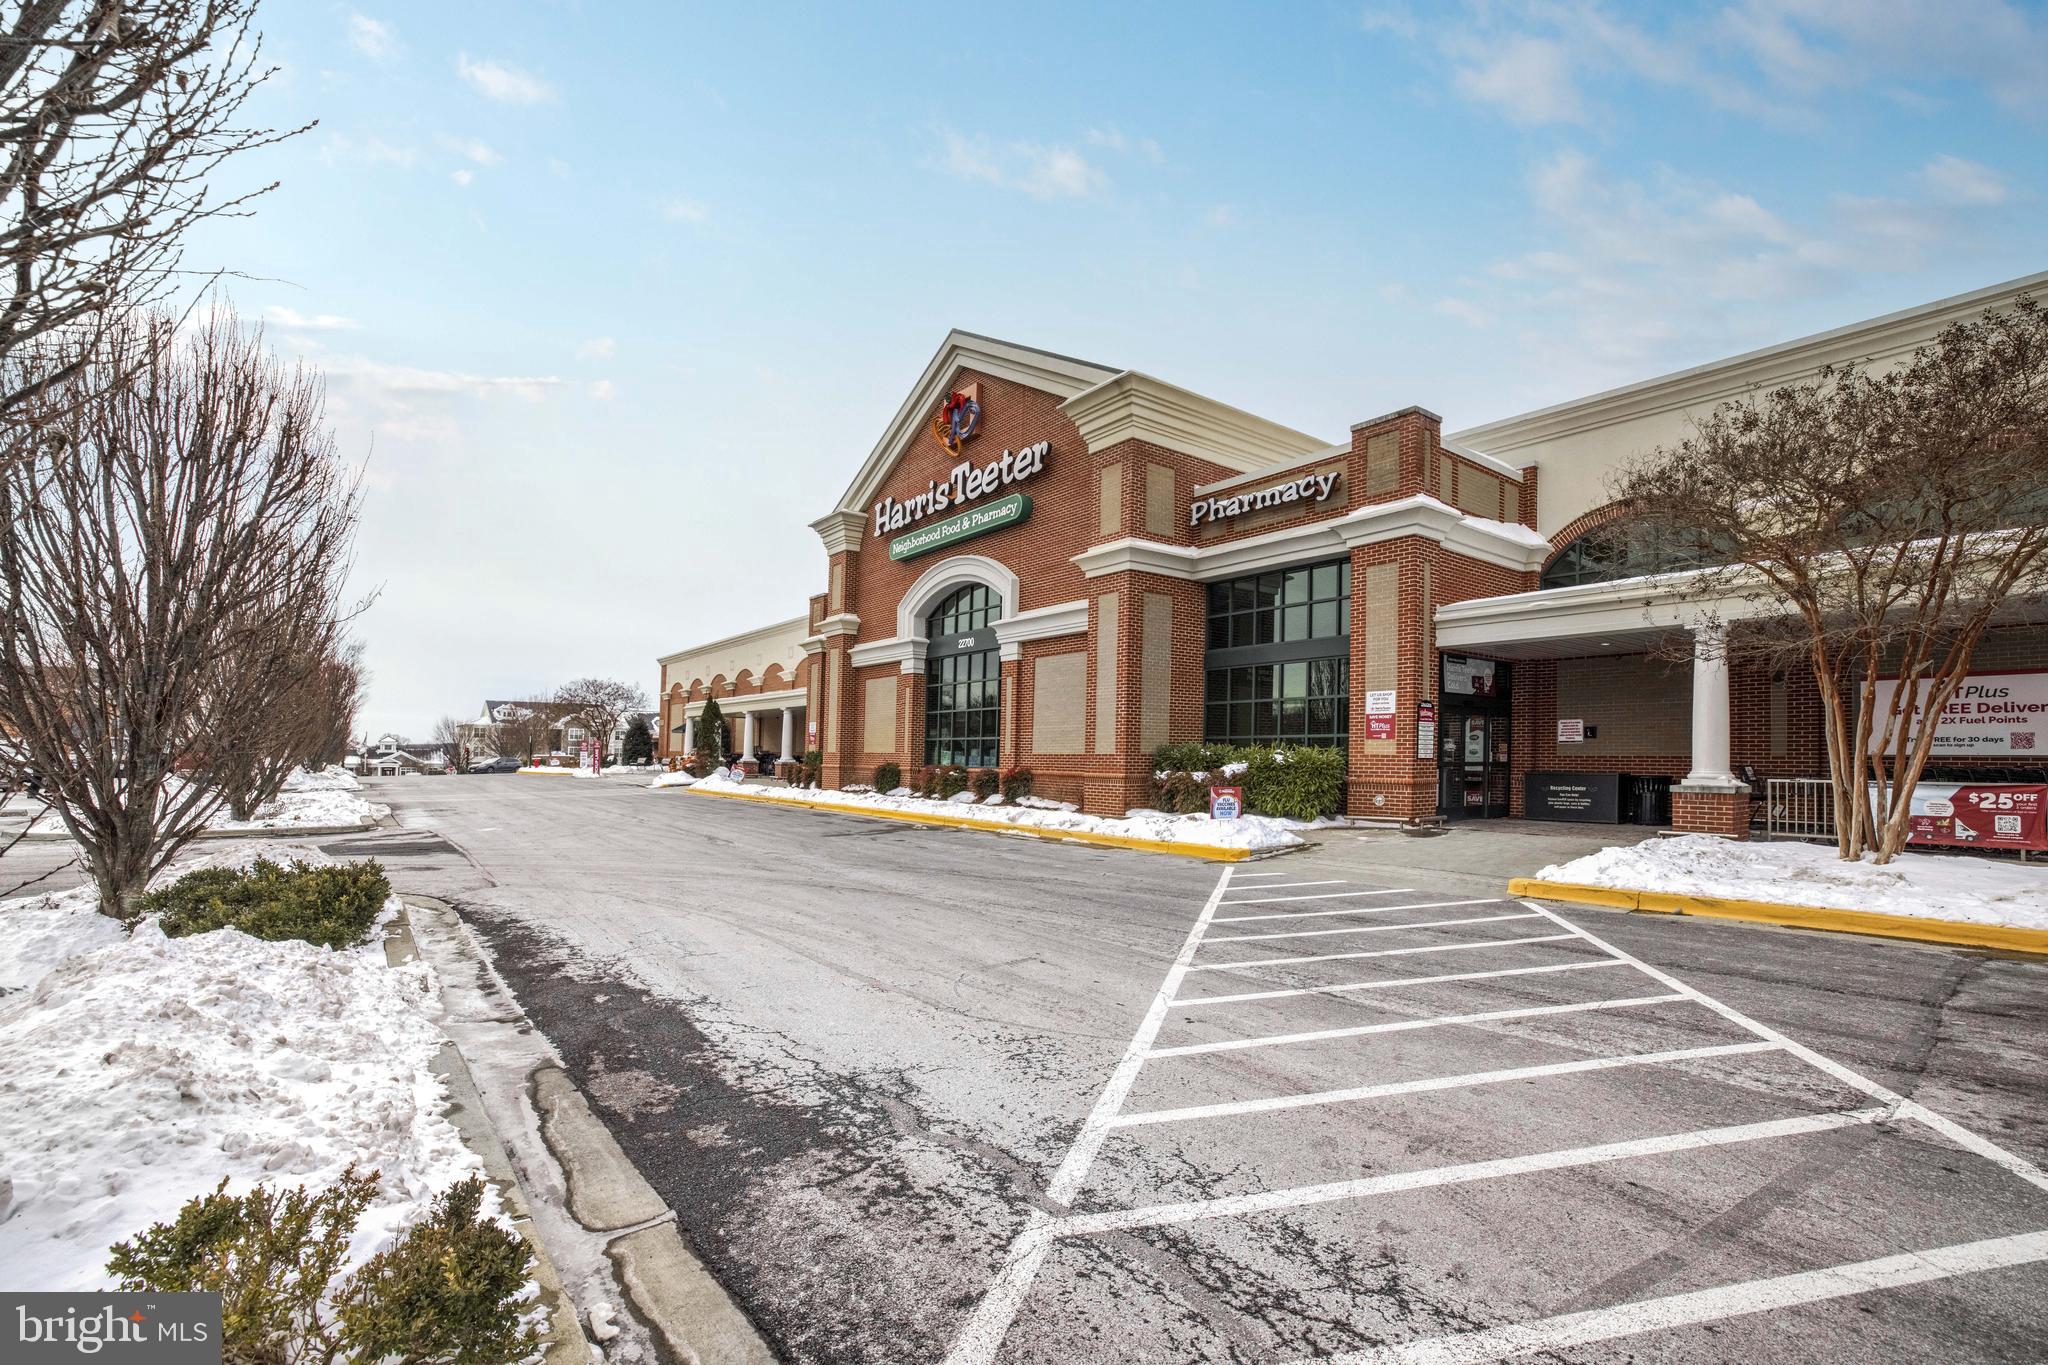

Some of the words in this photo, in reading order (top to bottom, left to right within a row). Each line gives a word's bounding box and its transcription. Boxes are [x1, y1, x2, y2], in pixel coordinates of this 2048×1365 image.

[874, 480, 949, 537] Harris
[950, 440, 1048, 504] Teeter
[1190, 472, 1338, 526] Pharmacy
[892, 526, 940, 555] Neighborhood
[941, 521, 960, 540] Food
[962, 516, 970, 530] &
[971, 502, 1017, 527] Pharmacy
[958, 637, 975, 649] 22700
[1965, 685, 2010, 699] Plus
[1941, 716, 1956, 725] 2X
[1959, 716, 1985, 725] Fuel
[1989, 715, 2029, 724] Points
[1982, 736, 2005, 744] days
[1969, 791, 2013, 809] $25
[2013, 793, 2038, 802] OFF
